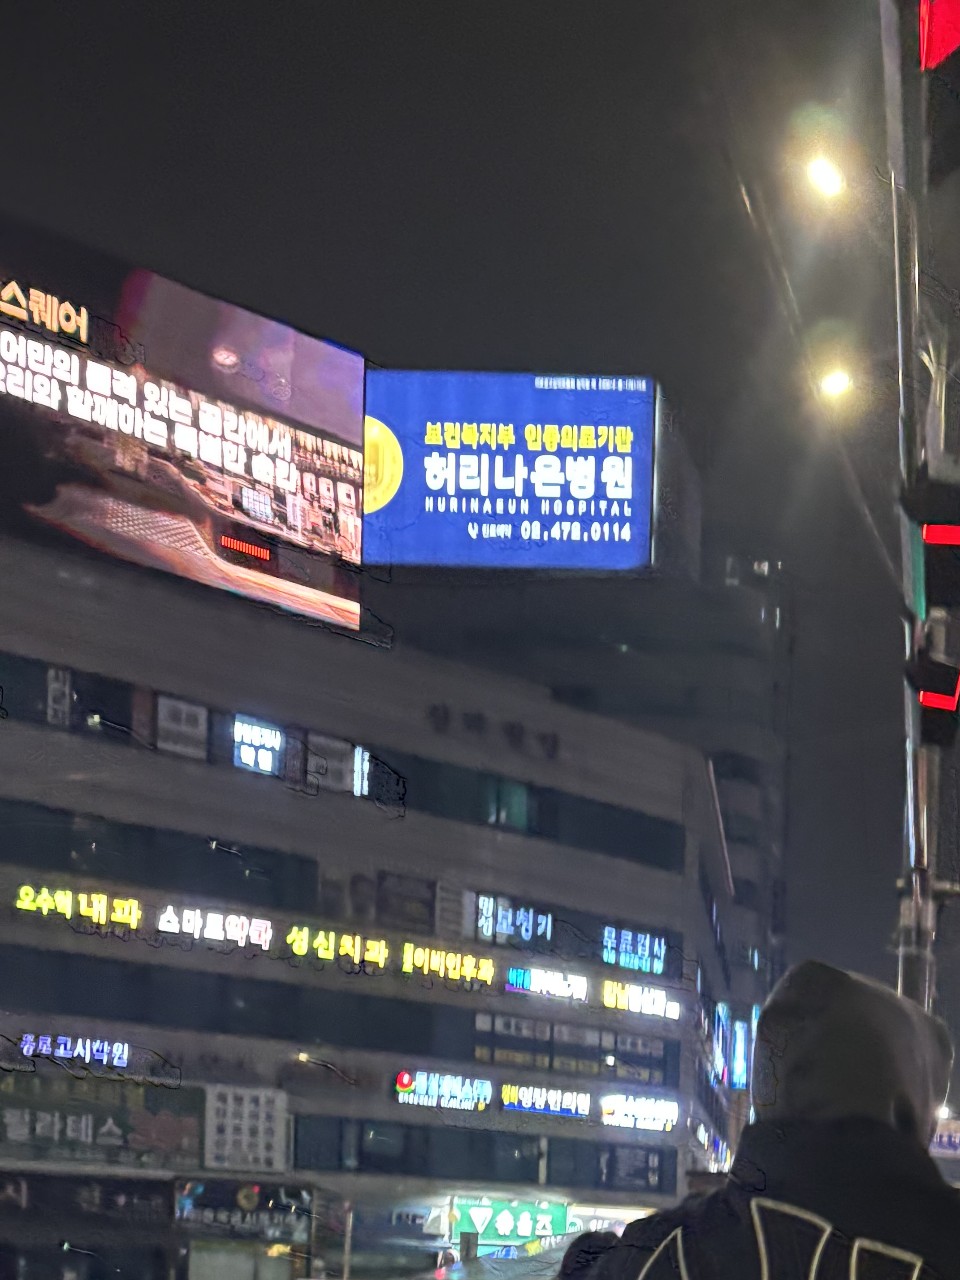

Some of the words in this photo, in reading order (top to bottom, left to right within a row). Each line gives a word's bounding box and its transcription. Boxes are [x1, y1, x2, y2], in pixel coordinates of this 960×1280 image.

[0, 280, 88, 343] 스퀘어
[66, 385, 168, 448] 함께하는
[144, 381, 193, 426] 있는
[424, 421, 516, 451] 보건복지부
[524, 423, 634, 453] 인증의료기관
[423, 452, 633, 500] 허리나은병원
[424, 496, 530, 515] HURINAEUN
[540, 499, 632, 517] HOSPITAL
[158, 904, 273, 951] 스마트약국
[286, 926, 389, 969] 성신치과
